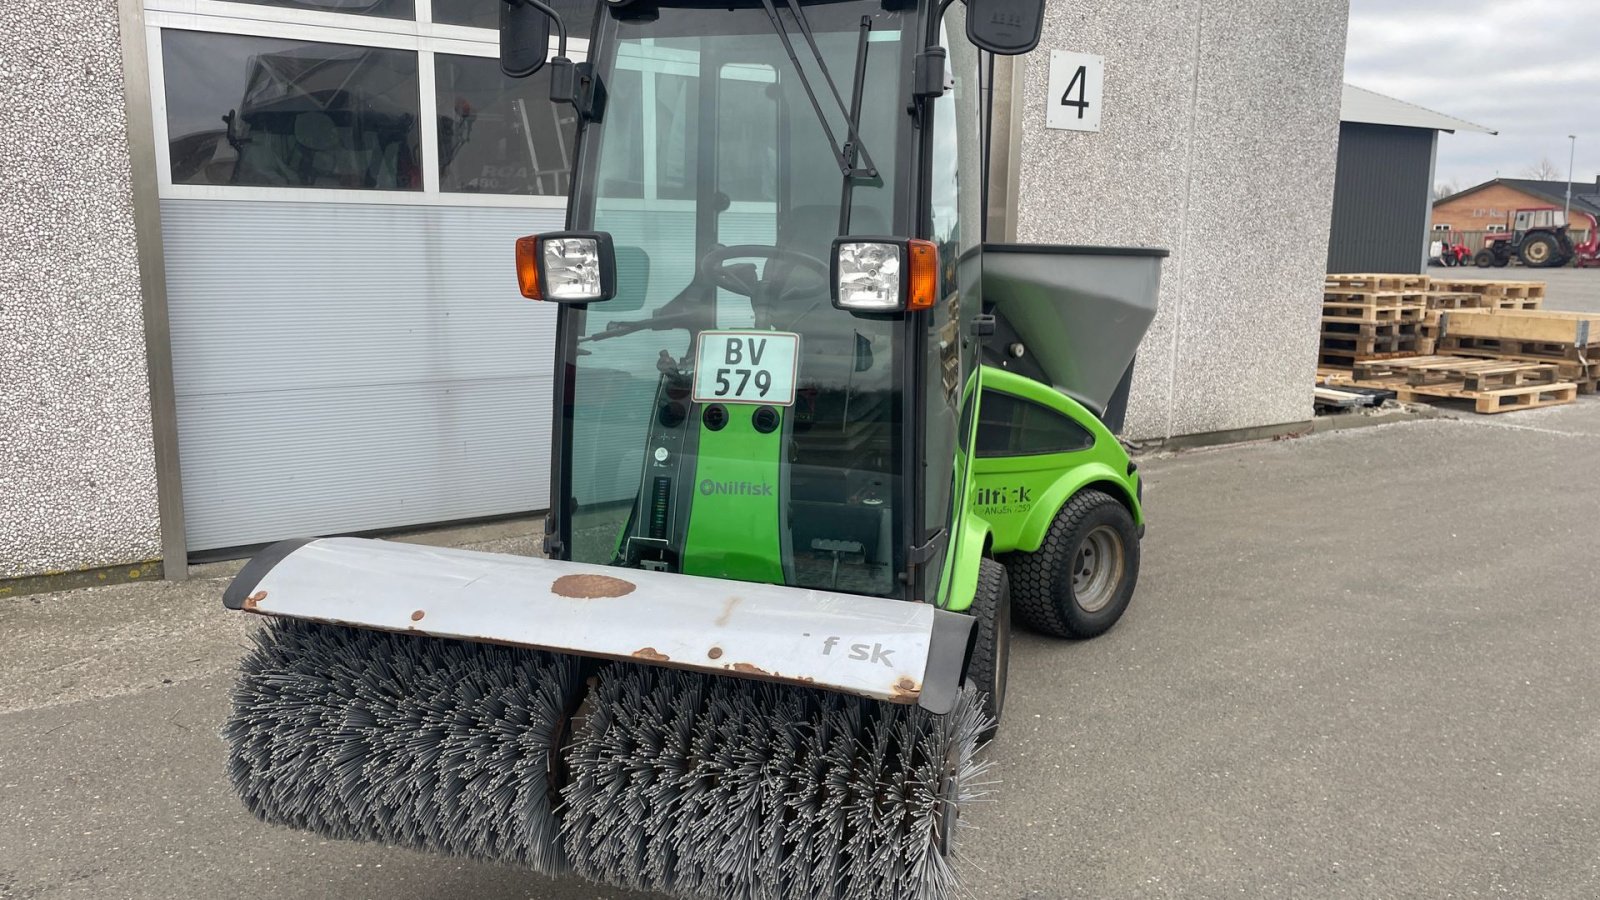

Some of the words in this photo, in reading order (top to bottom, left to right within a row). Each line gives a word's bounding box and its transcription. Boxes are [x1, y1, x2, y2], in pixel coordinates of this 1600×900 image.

[1061, 65, 1090, 119] 4
[725, 337, 767, 366] BV
[714, 368, 772, 397] 579
[715, 481, 774, 497] Nilfisk
